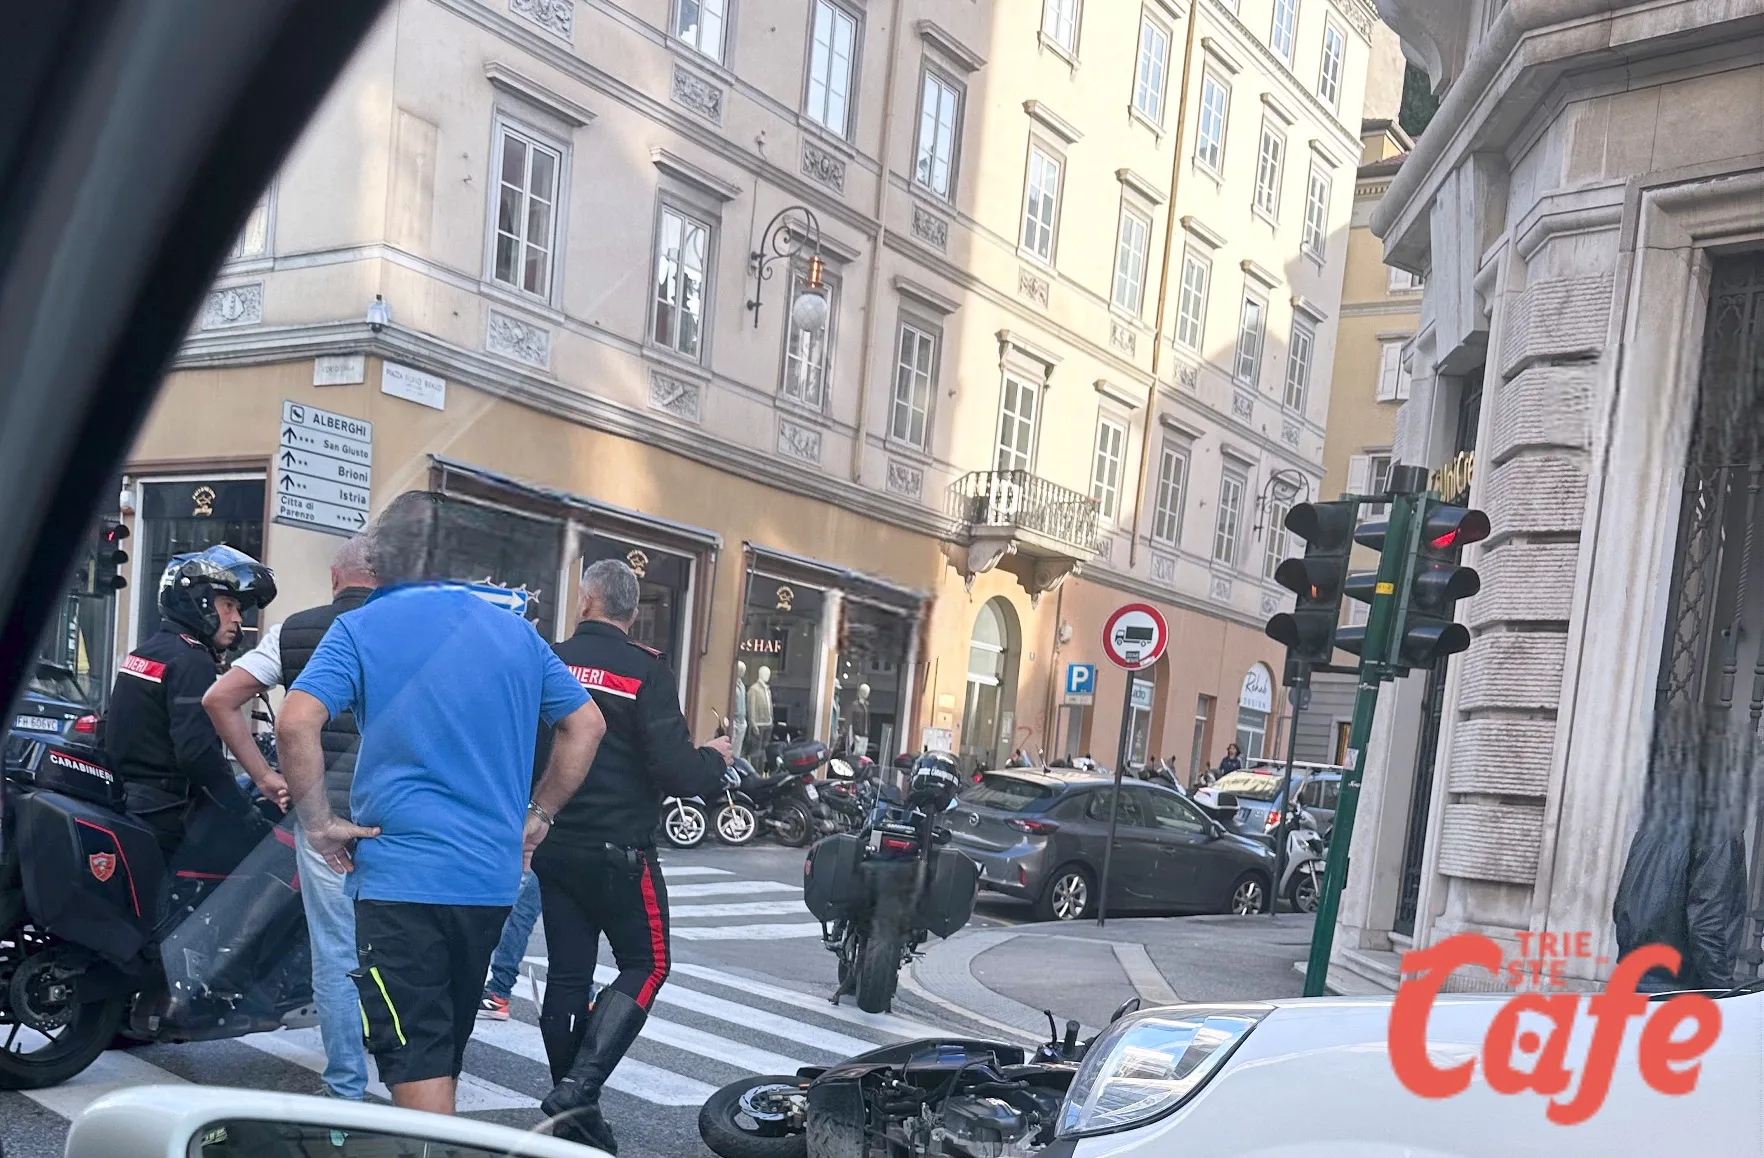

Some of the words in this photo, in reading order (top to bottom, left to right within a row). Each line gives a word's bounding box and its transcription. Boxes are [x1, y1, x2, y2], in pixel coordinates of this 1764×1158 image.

[313, 413, 366, 436] ALBERGHI
[323, 440, 340, 451] San
[342, 445, 369, 459] Giusto
[338, 466, 368, 482] Brioni
[306, 501, 314, 510] di
[340, 490, 367, 505] Istria
[280, 506, 315, 520] Parenzo
[1071, 666, 1089, 691] P
[50, 754, 114, 783] CARABINIERI
